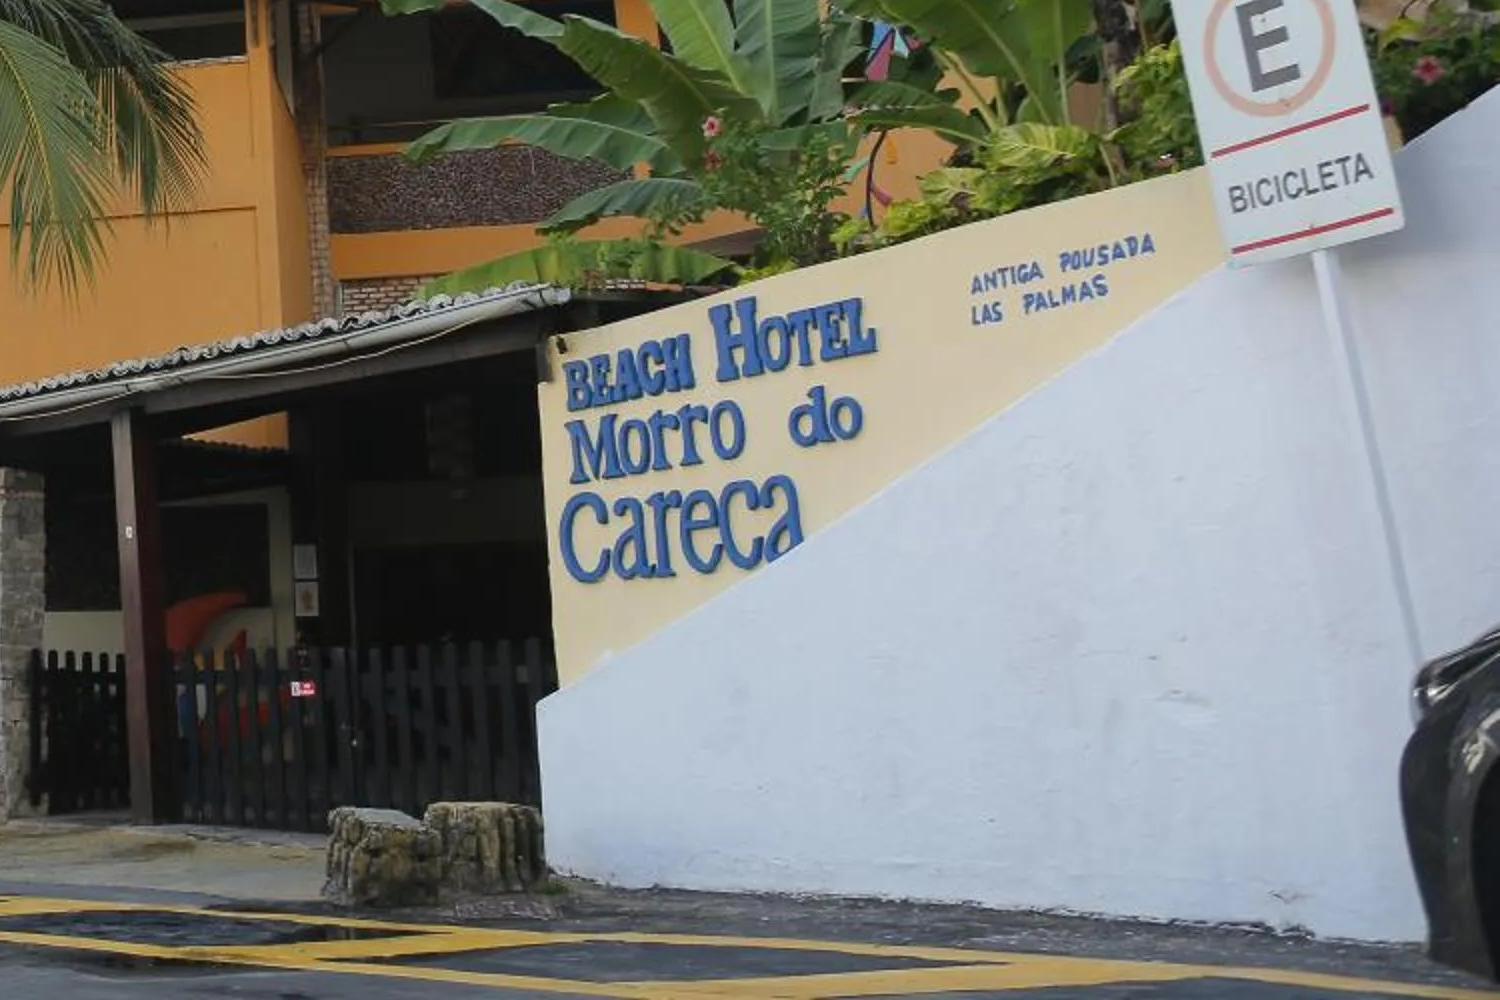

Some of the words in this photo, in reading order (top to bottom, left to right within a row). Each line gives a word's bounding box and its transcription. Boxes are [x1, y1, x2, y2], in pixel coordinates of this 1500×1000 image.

[1228, 152, 1375, 214] BICICLETA
[970, 260, 1045, 295] ANTIGA
[1058, 232, 1156, 273] POUSADA
[971, 301, 1004, 326] LAS
[1022, 273, 1109, 315] PALMAS
[562, 333, 697, 413] BEACH
[707, 295, 880, 383] HOTEL
[563, 399, 747, 485] Morro
[787, 384, 865, 448] do
[559, 474, 805, 585] Careca
